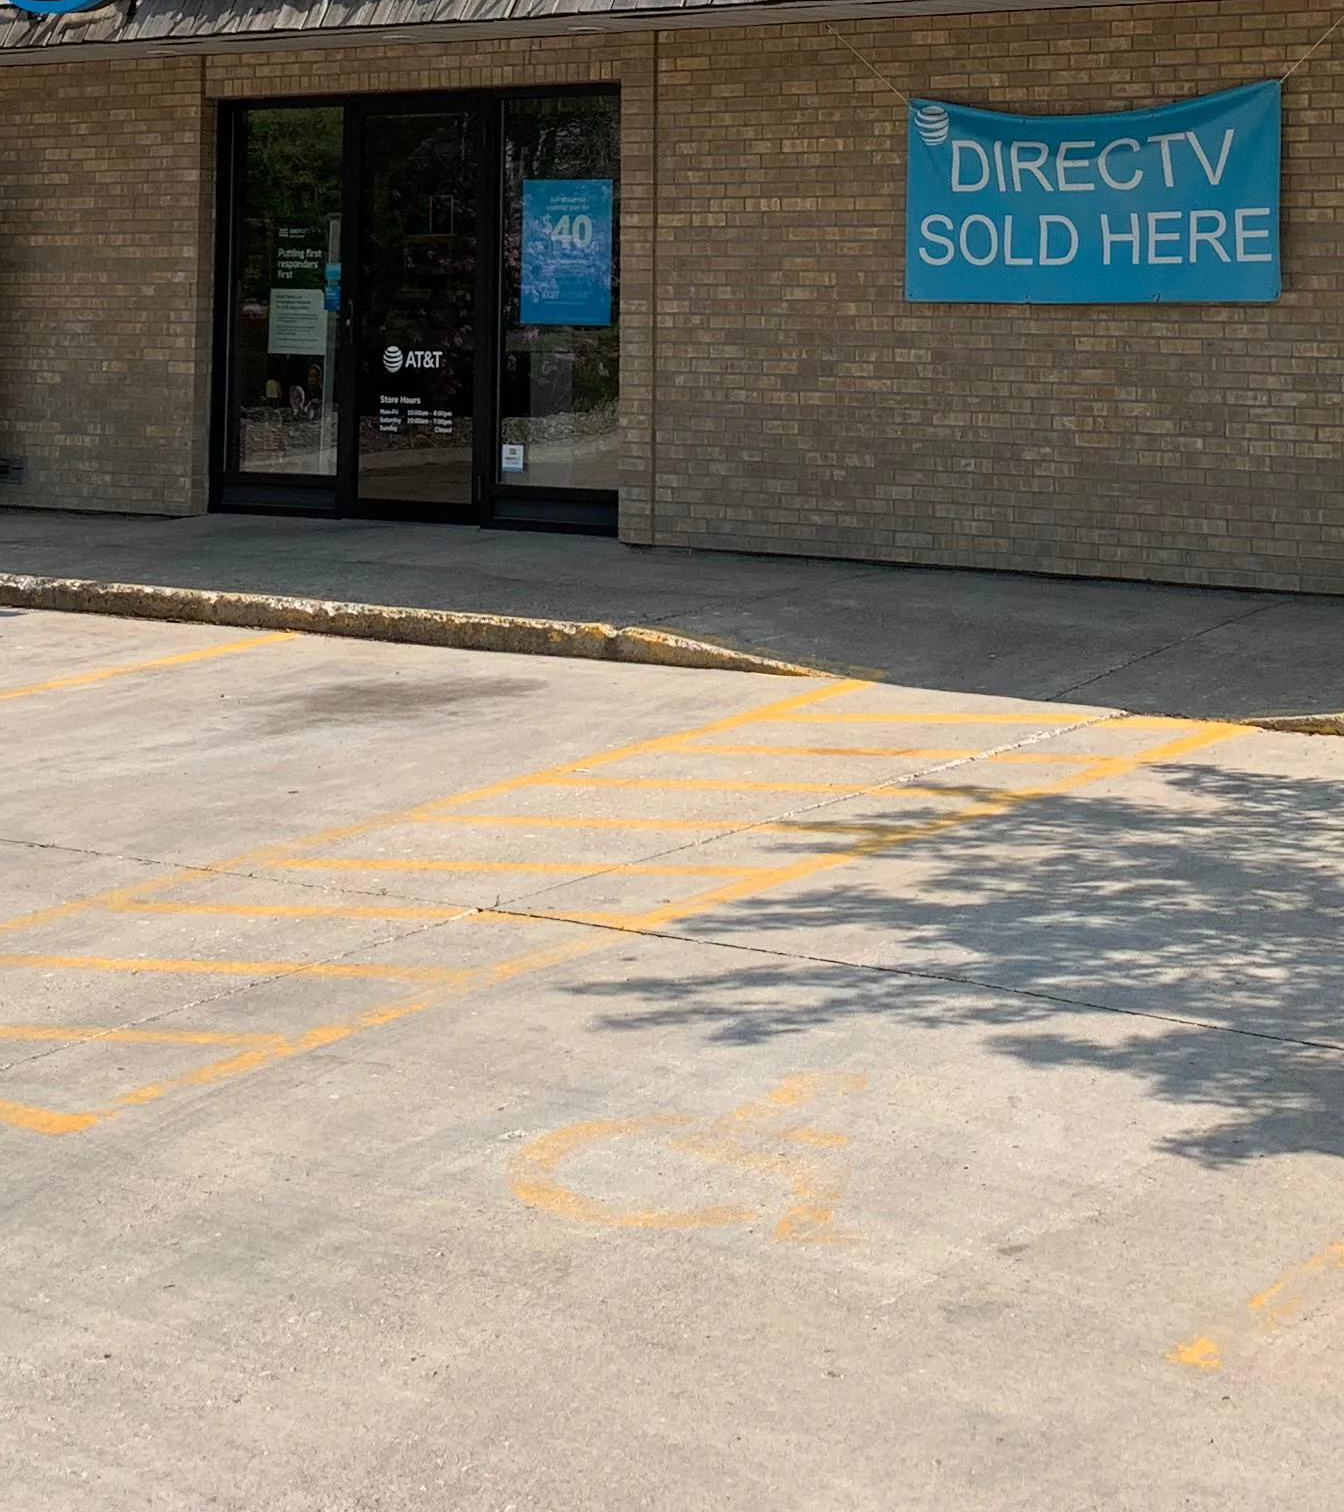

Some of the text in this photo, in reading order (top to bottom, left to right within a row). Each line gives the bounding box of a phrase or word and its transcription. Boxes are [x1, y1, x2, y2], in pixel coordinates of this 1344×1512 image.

[950, 128, 1236, 193] DIRECTV
[543, 214, 593, 249] $40
[918, 207, 1273, 267] SOLD HERE
[278, 248, 322, 260] Putting first
[278, 260, 319, 270] responders
[278, 269, 294, 279] first
[405, 350, 443, 368] AT&T
[380, 395, 421, 404] Store Hours
